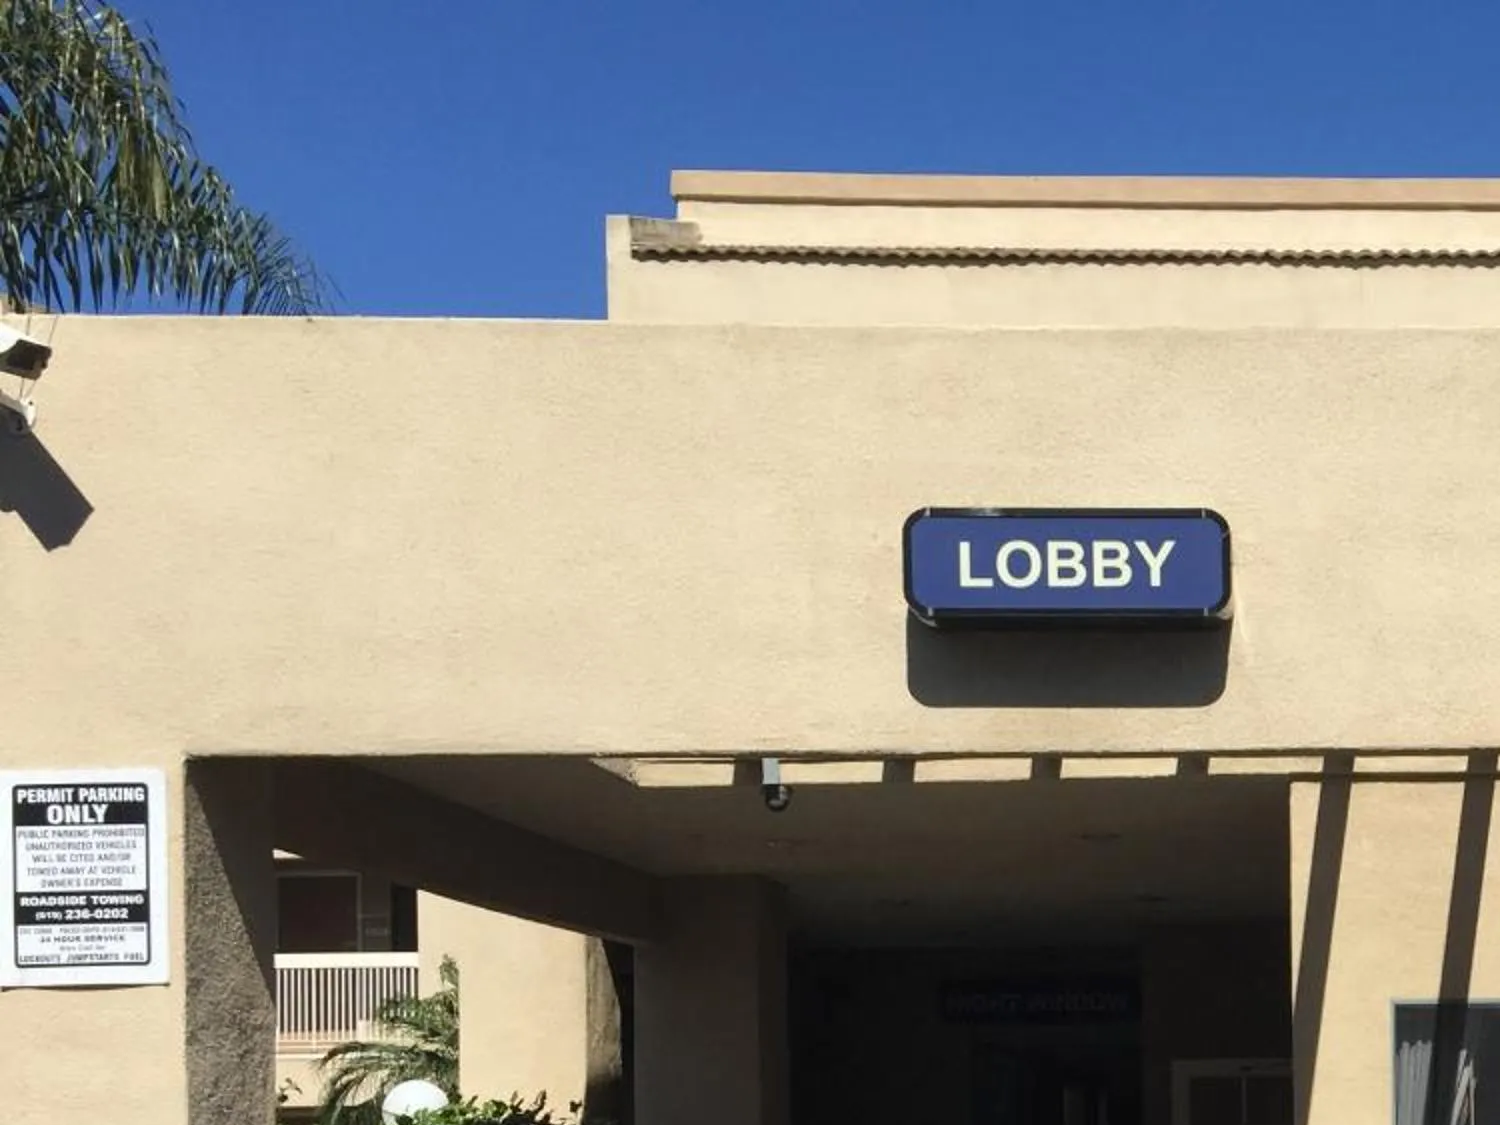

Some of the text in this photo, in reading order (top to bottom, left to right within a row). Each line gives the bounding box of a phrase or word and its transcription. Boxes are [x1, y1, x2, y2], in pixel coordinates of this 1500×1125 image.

[959, 539, 1177, 588] LOBBY
[17, 786, 145, 804] PERMIT PARKING
[46, 803, 109, 825] ONLY
[18, 828, 145, 839] PUBLIC PARKING PROHIBITED
[25, 840, 137, 851] UNAUTHORIZED VEHICLES
[32, 853, 54, 863] WILL
[56, 853, 67, 863] BE
[69, 853, 95, 863] CITED
[27, 865, 136, 876] TOWED AWAY AT VEHICLE
[84, 877, 123, 887] EXPENSE
[20, 893, 145, 907] ROADSIDE TOWING
